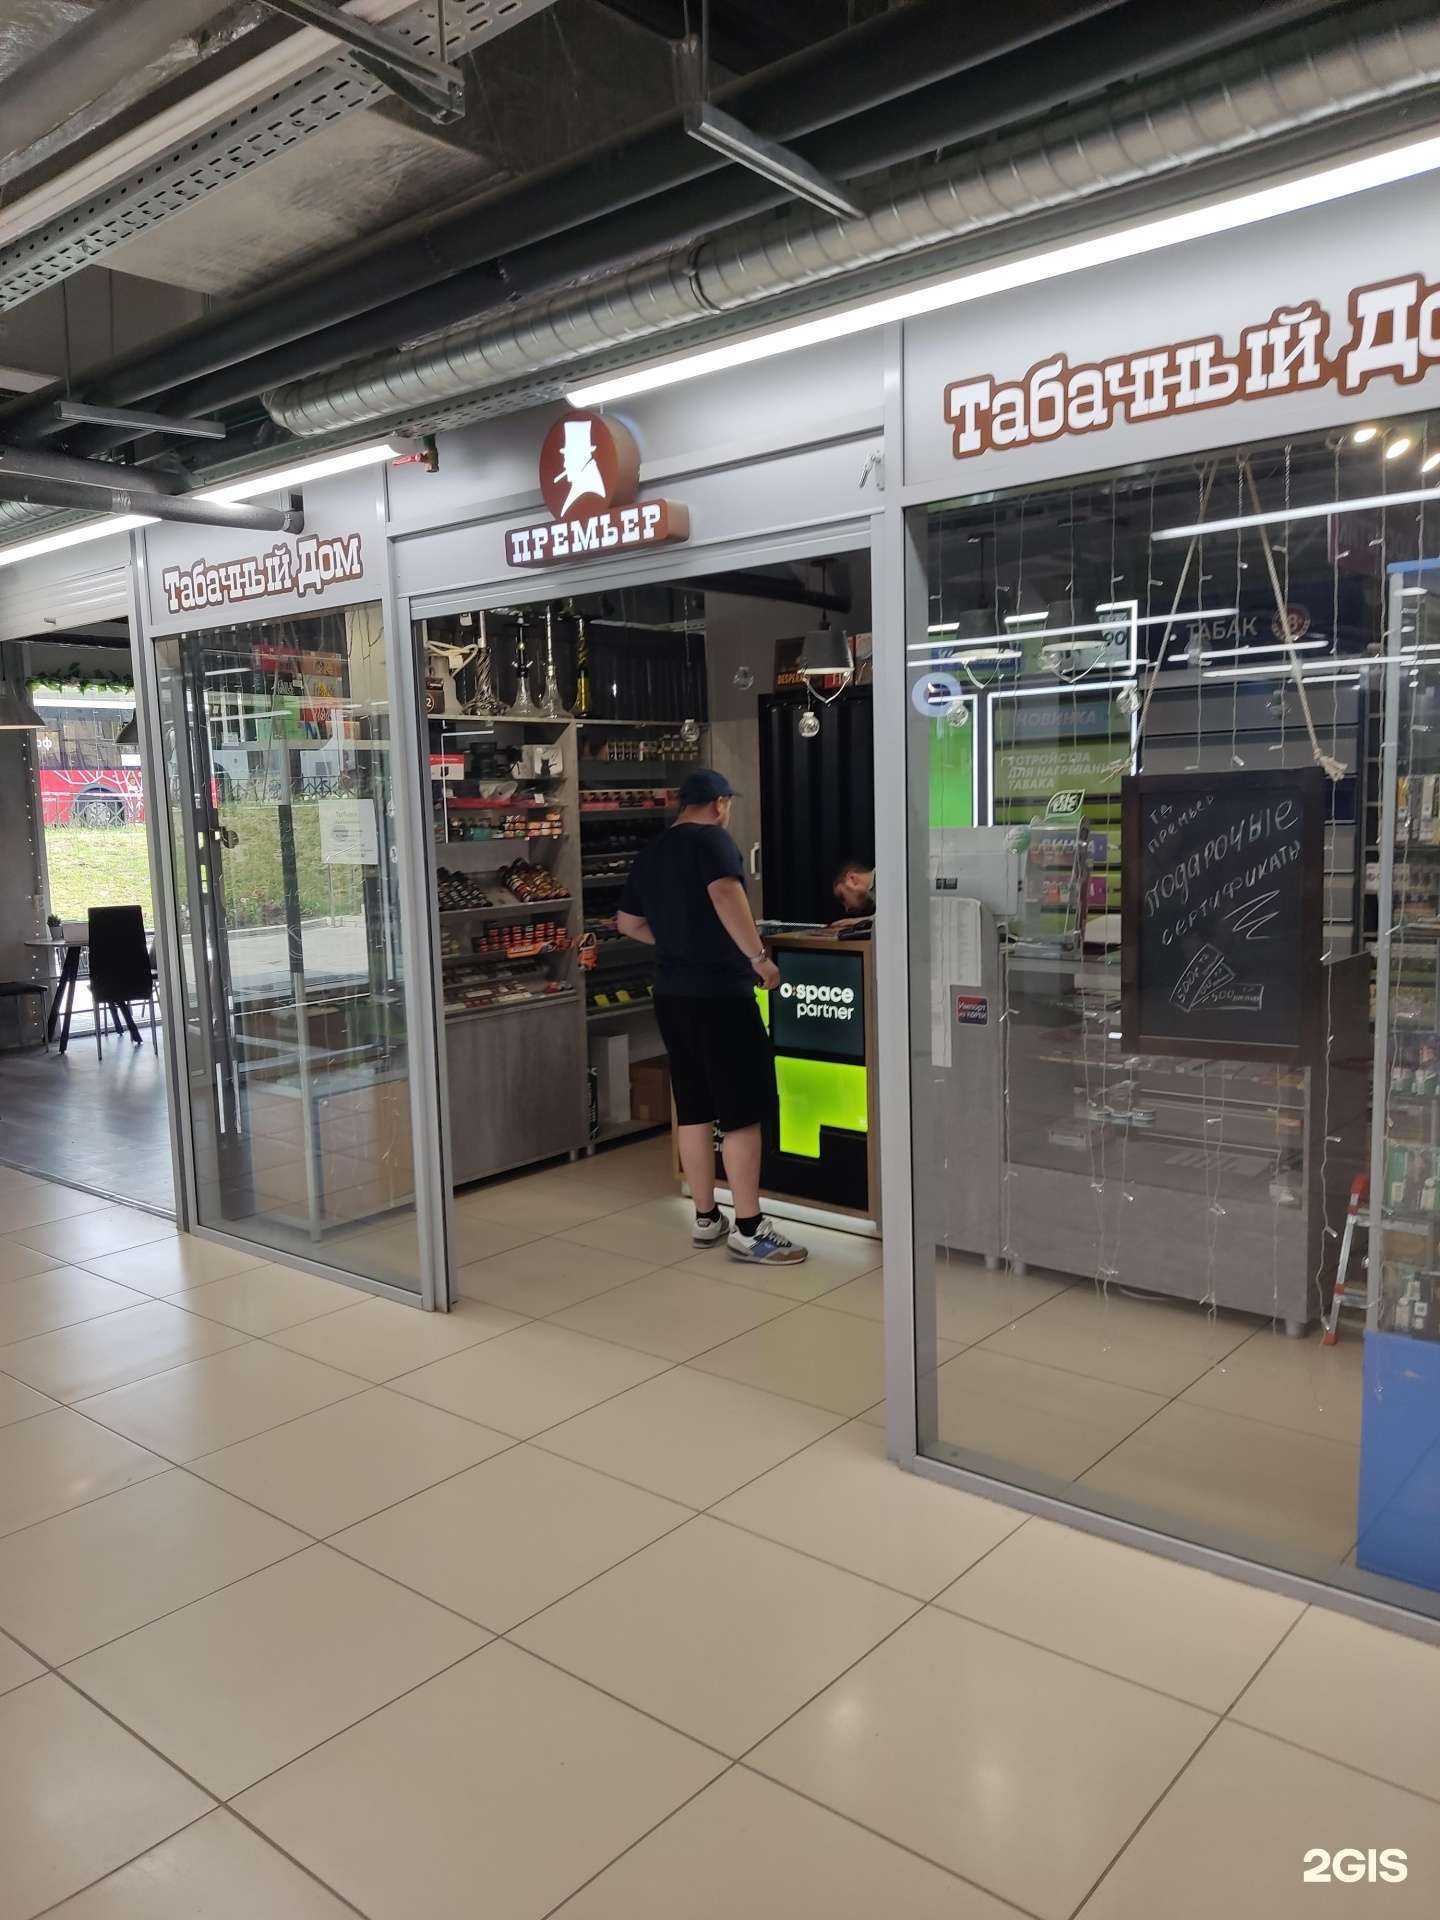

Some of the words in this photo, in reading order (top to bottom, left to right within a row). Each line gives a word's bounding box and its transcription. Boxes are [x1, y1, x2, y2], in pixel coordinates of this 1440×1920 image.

[948, 306, 1324, 455] Табачный
[510, 503, 662, 564] ПРЕМЬЕР
[163, 548, 292, 612] Табачный
[1186, 616, 1259, 641] ТАБАК
[797, 1003, 855, 1020] partner
